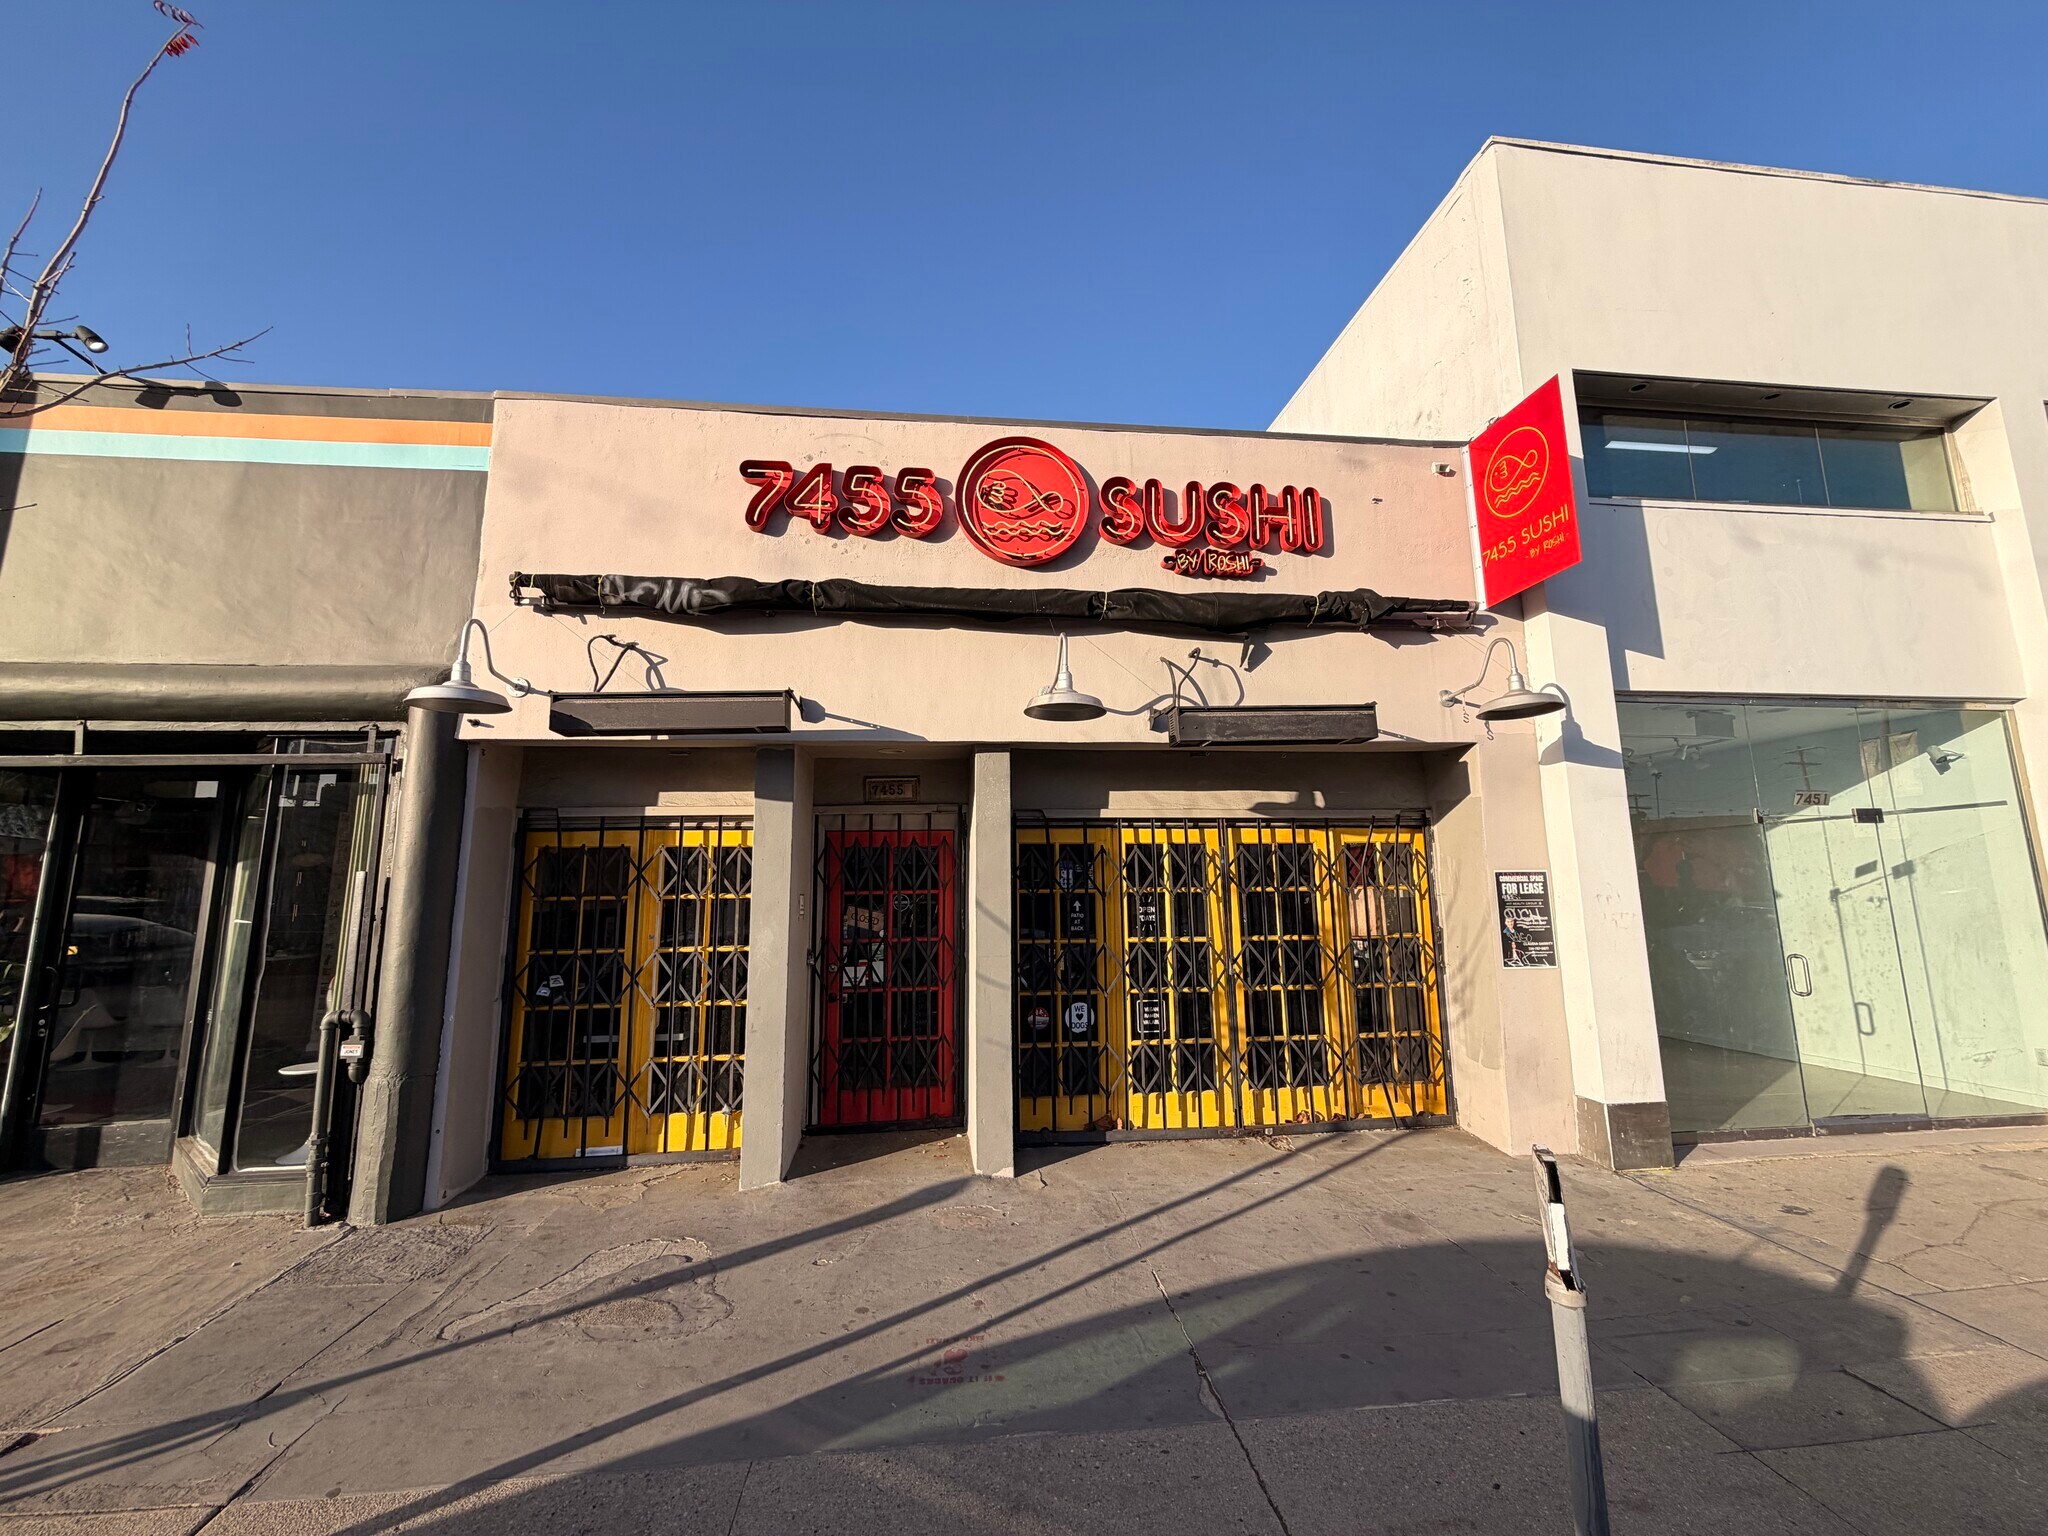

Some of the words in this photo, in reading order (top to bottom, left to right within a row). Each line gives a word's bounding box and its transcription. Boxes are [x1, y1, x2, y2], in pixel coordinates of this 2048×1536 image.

[739, 460, 943, 538] 7455
[1099, 476, 1325, 554] SUSHI
[1482, 536, 1517, 567] 7455
[1521, 504, 1569, 544] SUSHI
[872, 784, 903, 796] 7455
[1796, 793, 1828, 805] 7451
[1502, 883, 1518, 894] FOR
[1519, 883, 1545, 894] LEASE
